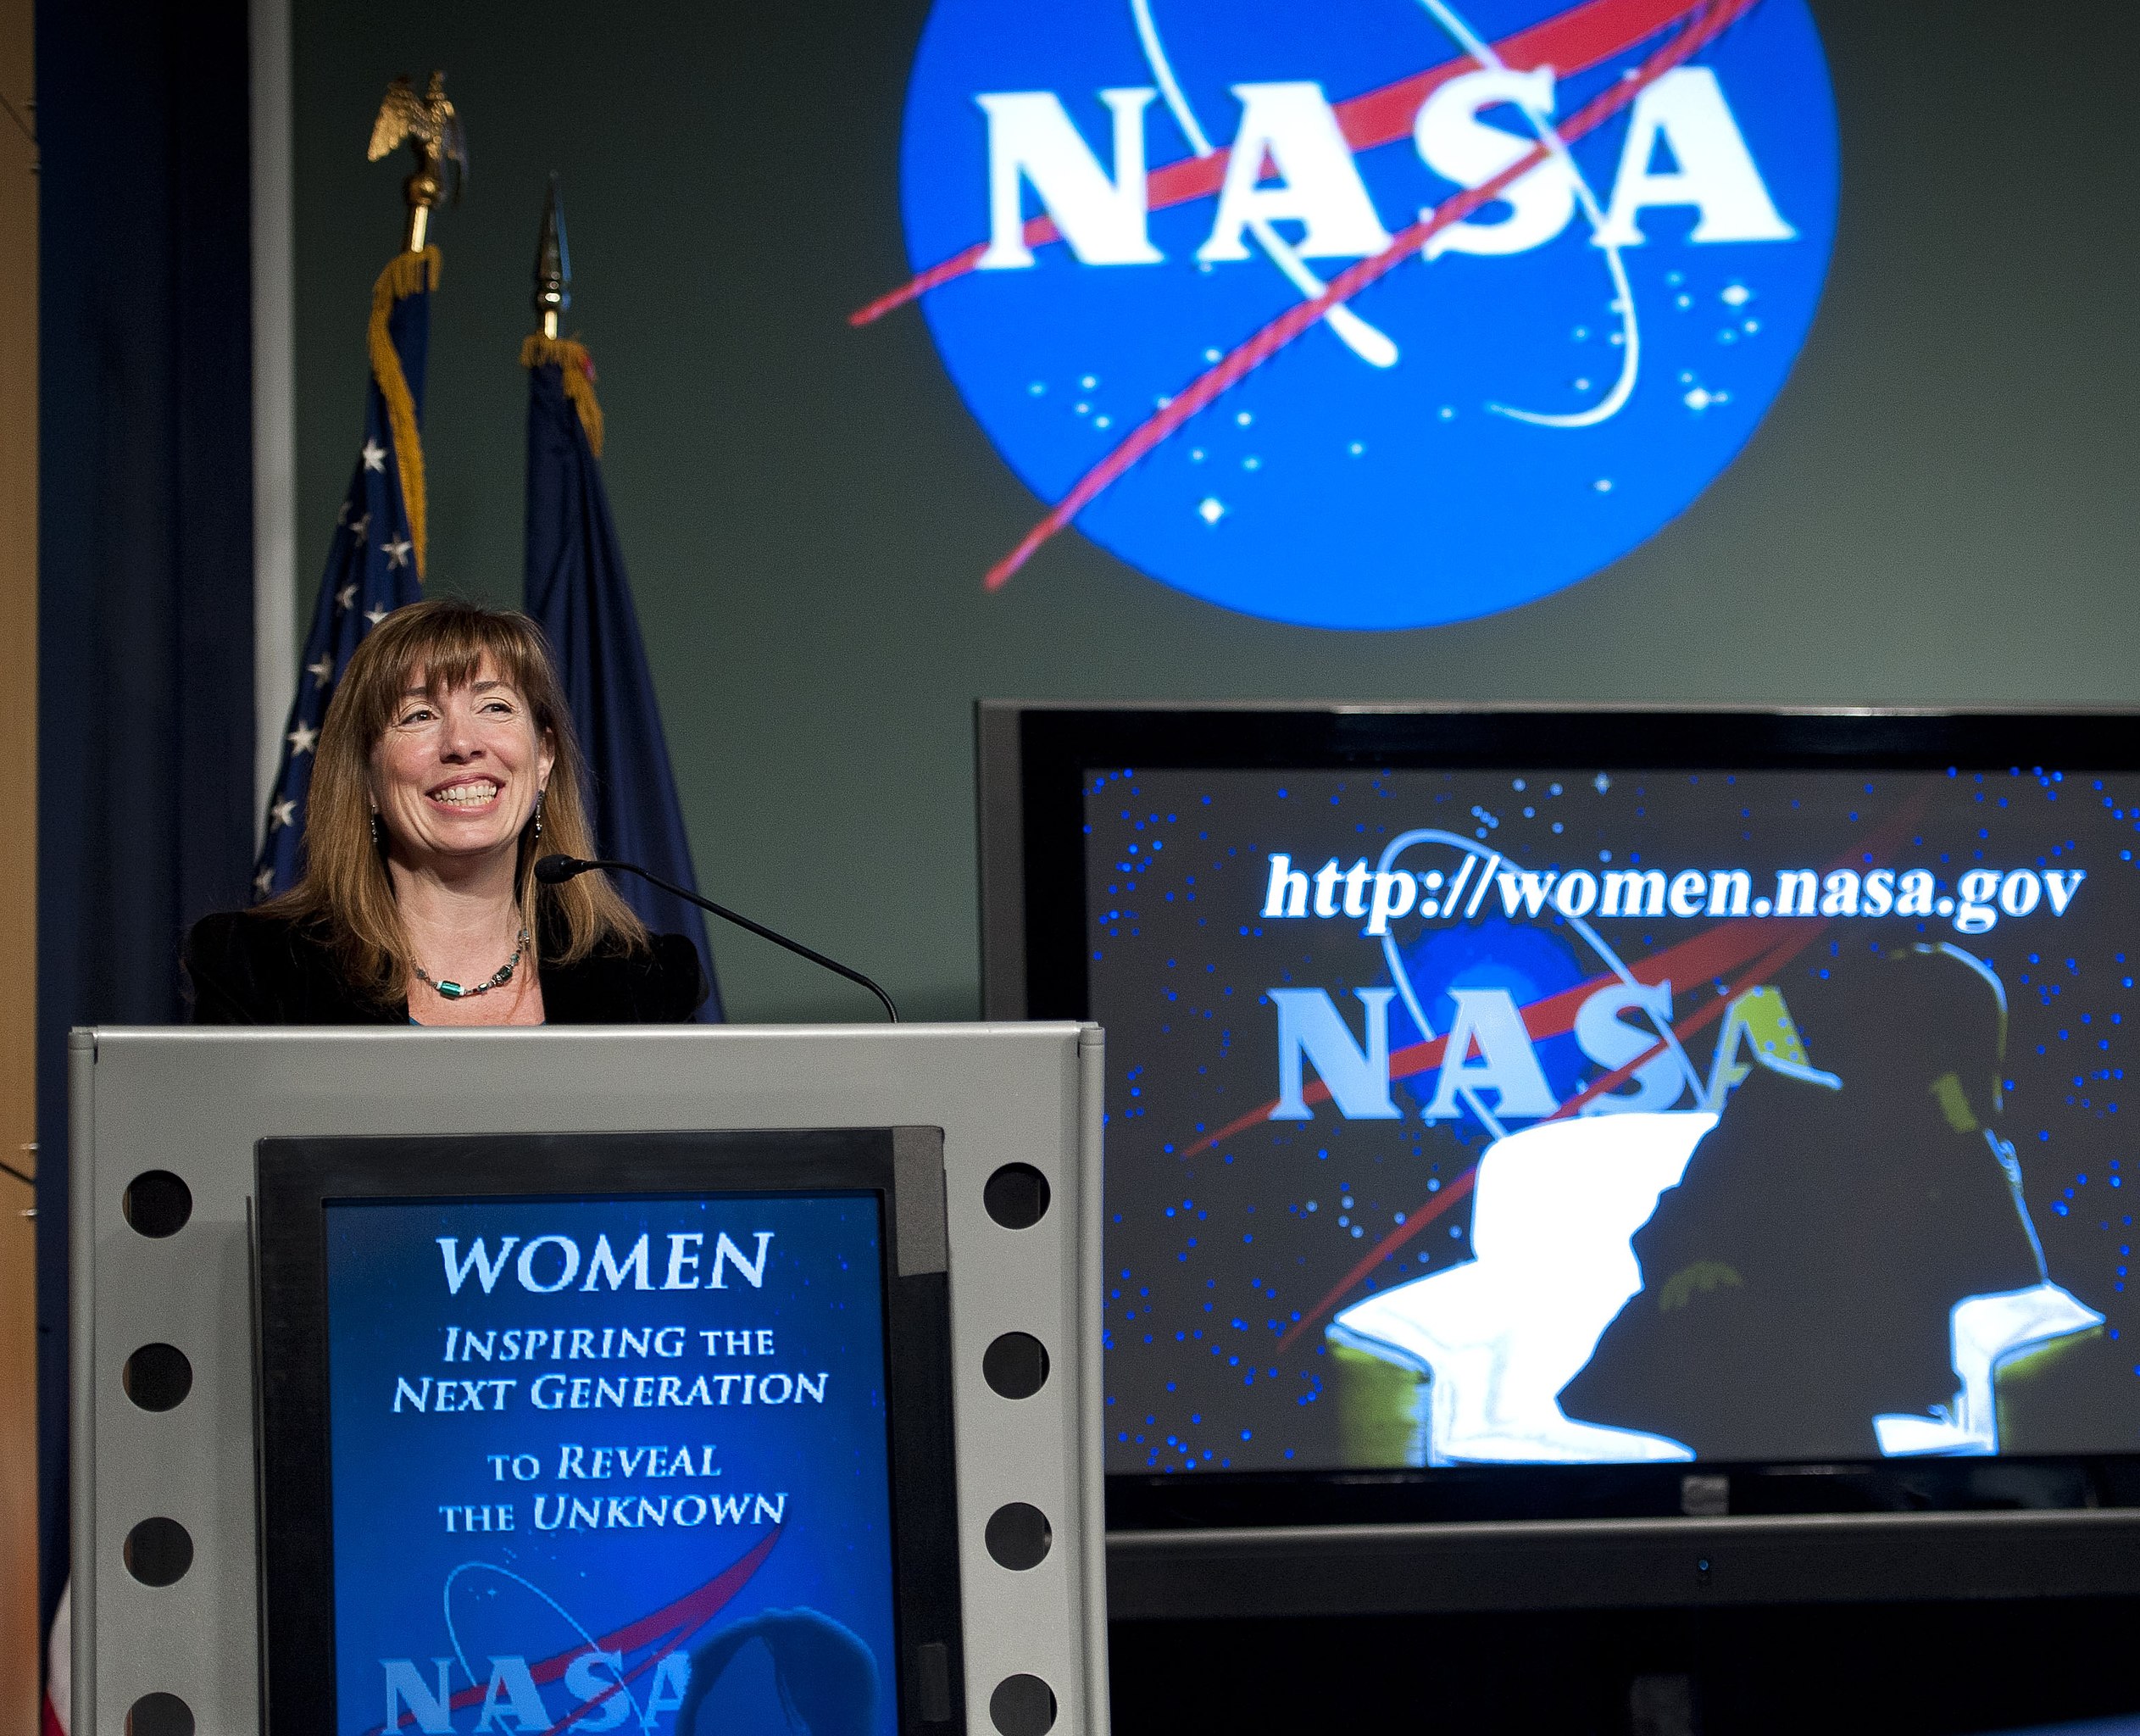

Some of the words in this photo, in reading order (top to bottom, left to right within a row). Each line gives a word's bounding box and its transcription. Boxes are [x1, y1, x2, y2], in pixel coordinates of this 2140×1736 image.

[975, 64, 1798, 270] NASA
[1260, 852, 2086, 934] http://women.nasa.gov
[436, 1232, 775, 1294] WOMEN
[443, 1327, 686, 1362] INSPIRING
[700, 1330, 775, 1355] THE
[392, 1377, 516, 1413] NEXT
[531, 1372, 829, 1410] GENERATION
[487, 1455, 540, 1482] TO
[556, 1444, 721, 1480] REVEAL
[439, 1505, 514, 1533] THE
[534, 1493, 788, 1530] UNKNOWN
